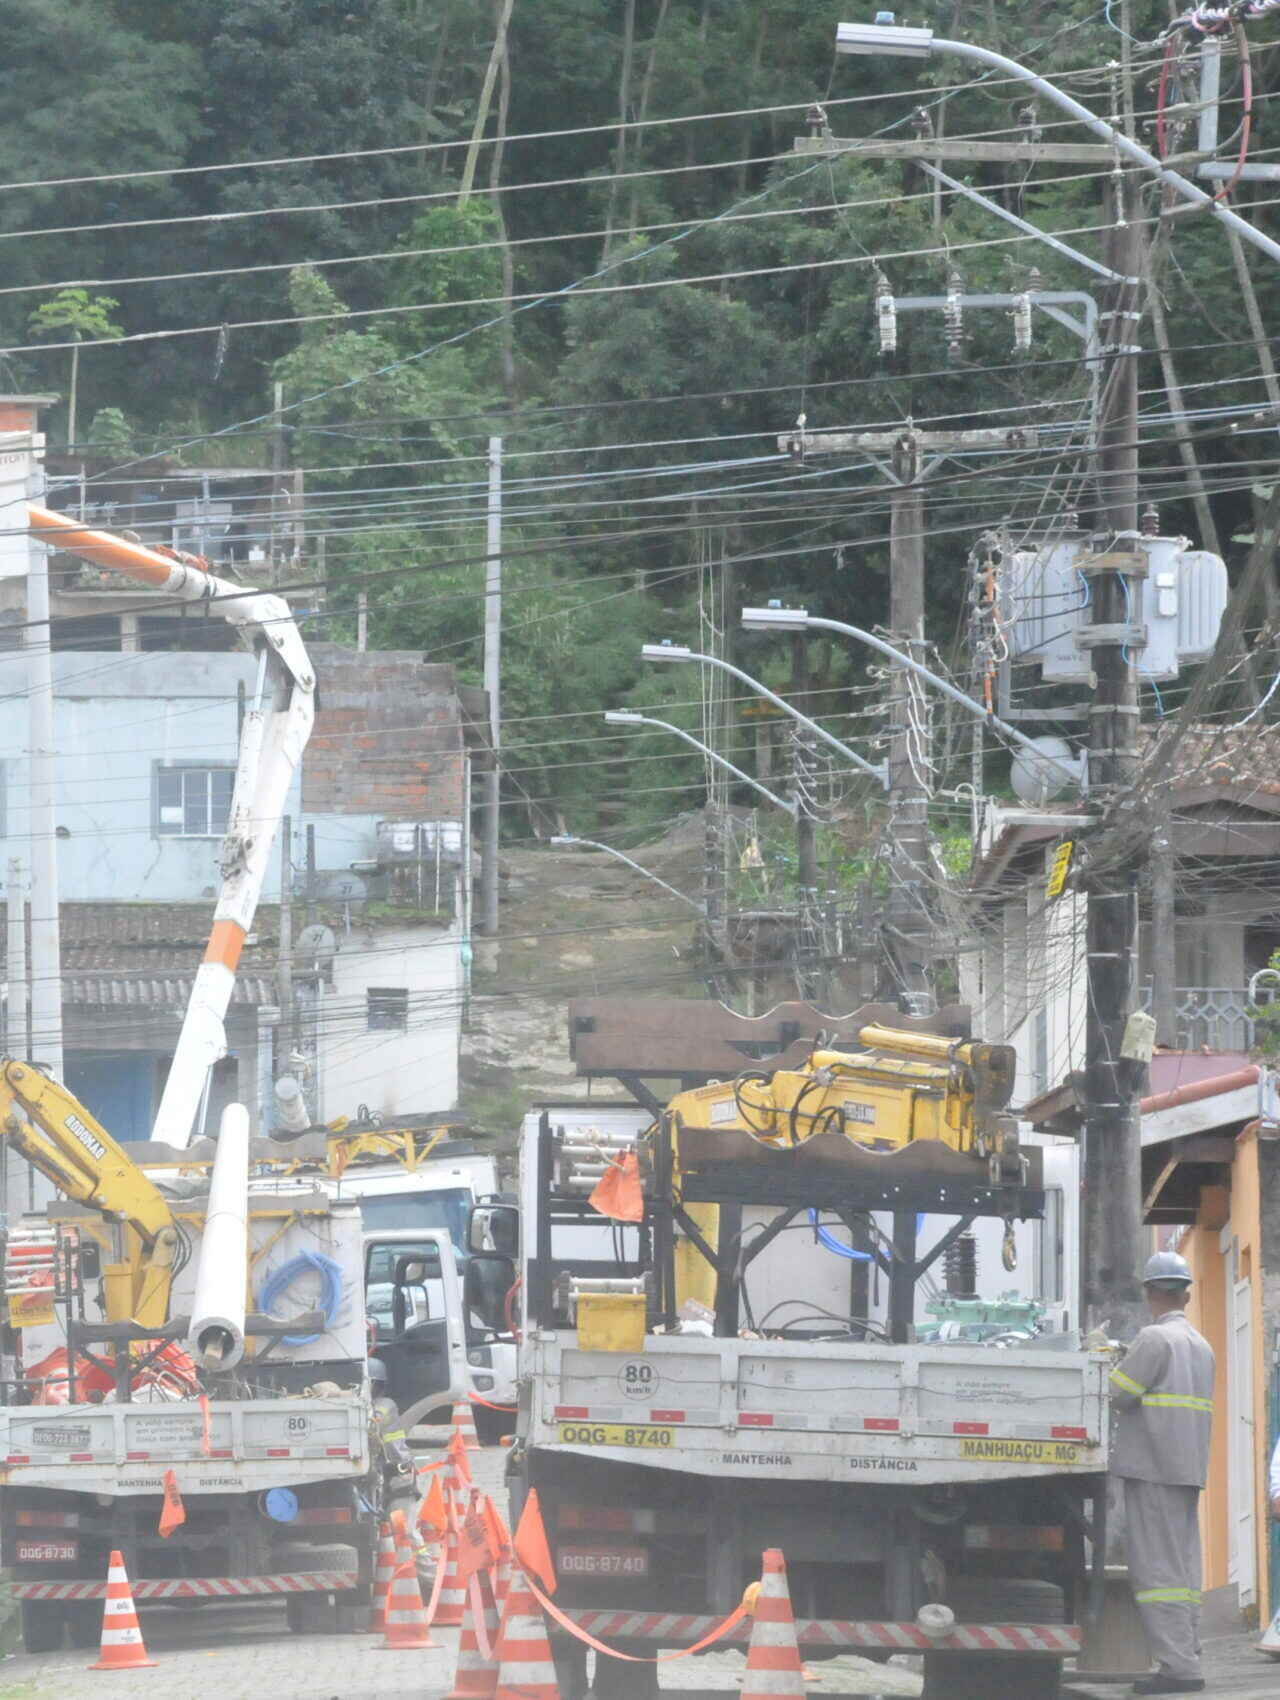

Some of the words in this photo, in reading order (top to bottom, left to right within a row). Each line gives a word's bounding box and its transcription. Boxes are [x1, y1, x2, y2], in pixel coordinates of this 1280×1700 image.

[625, 1365, 652, 1382] 80
[626, 1385, 651, 1394] km/h
[288, 1417, 306, 1430] 80
[563, 1428, 606, 1443] OQG
[624, 1429, 670, 1445] 8740
[1055, 1445, 1077, 1460] MG
[722, 1454, 793, 1466] MANTENHA
[850, 1454, 918, 1471] DISTÂNCIA
